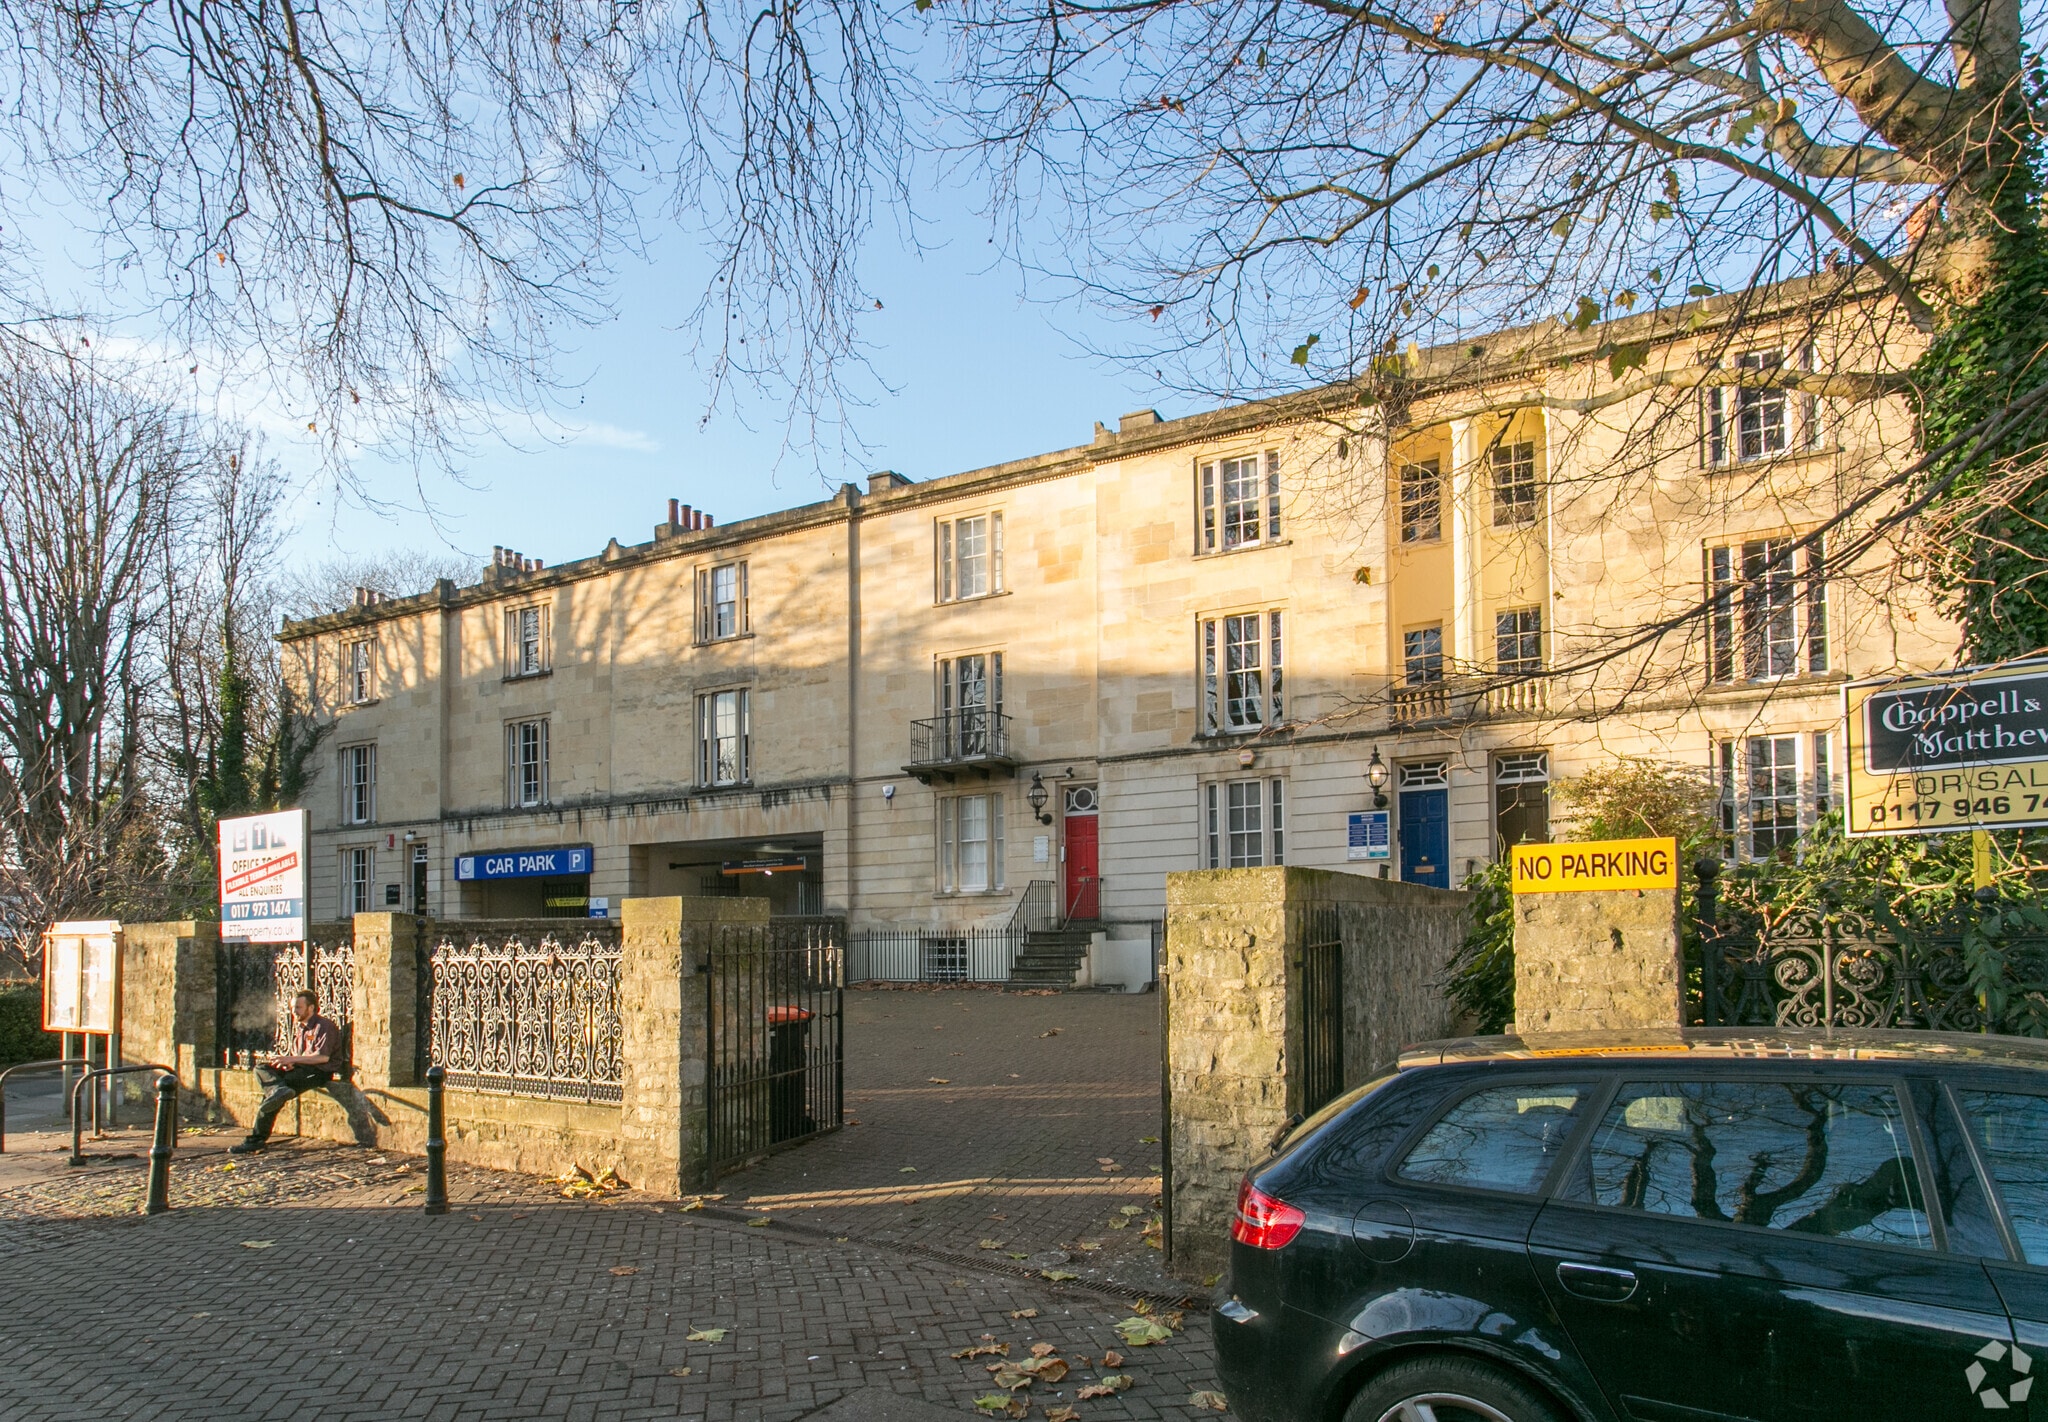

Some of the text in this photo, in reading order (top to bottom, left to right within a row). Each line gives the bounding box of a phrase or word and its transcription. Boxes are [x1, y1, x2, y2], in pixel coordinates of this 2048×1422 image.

[1895, 774, 1961, 797] FOR
[1870, 801, 1942, 823] 0117
[1953, 796, 2011, 817] 946
[485, 853, 581, 875] CAR PARK P
[1519, 850, 1668, 881] NO PARKING
[250, 884, 283, 897] ENQUIRIES
[231, 901, 291, 919] 0117 973 1474
